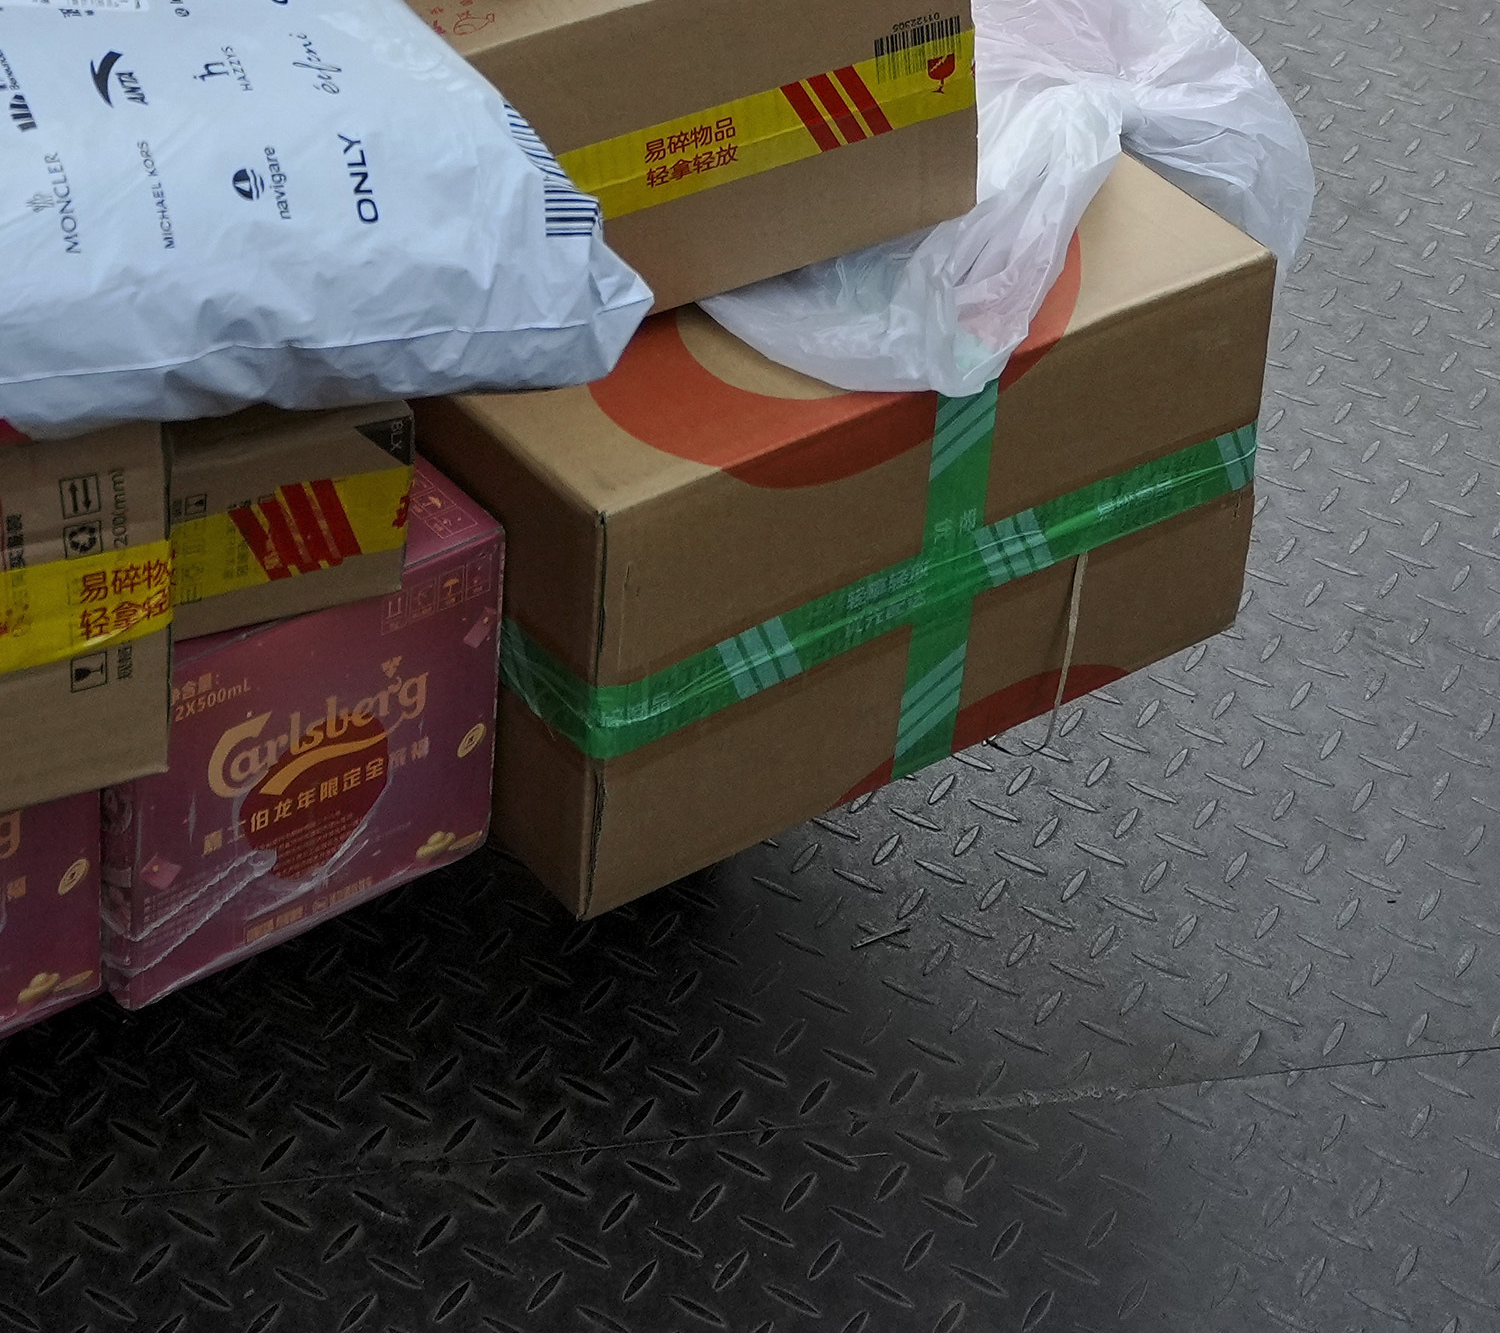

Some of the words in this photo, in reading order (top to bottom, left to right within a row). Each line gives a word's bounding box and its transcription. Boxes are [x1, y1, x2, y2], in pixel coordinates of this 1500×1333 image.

[137, 140, 159, 179] KORS
[644, 116, 737, 164] 易碎物品
[646, 143, 739, 189] 轻拿轻放
[57, 151, 85, 255] MONCLER
[263, 145, 293, 221] navigare
[337, 133, 380, 224] ONLY
[152, 182, 175, 250] MICHAEL
[207, 666, 430, 801] Carlsberg
